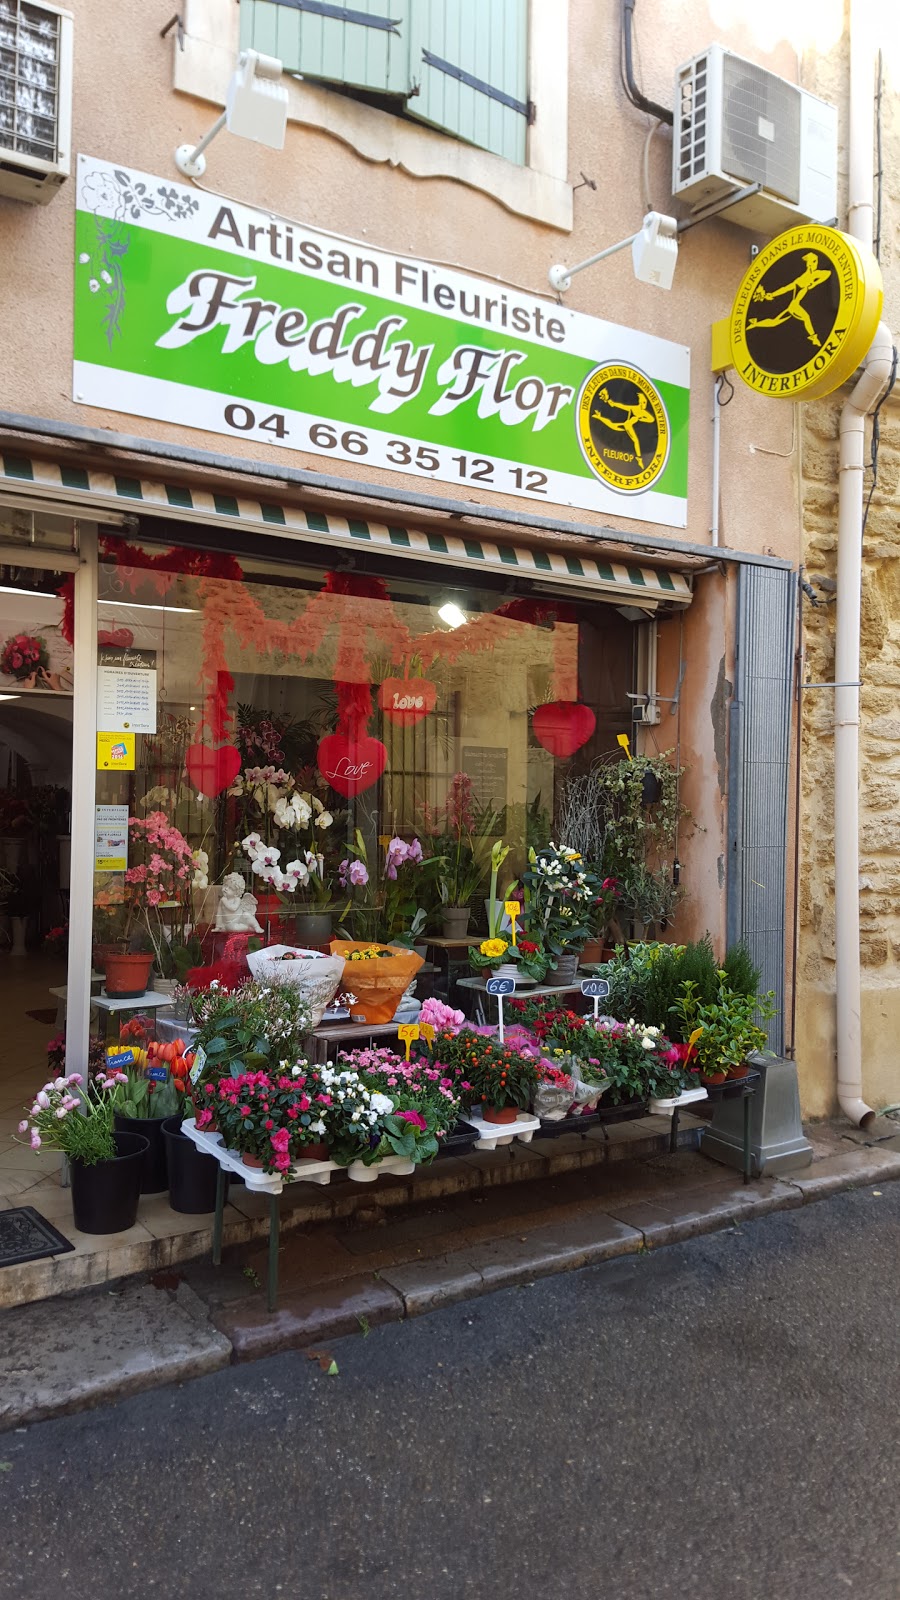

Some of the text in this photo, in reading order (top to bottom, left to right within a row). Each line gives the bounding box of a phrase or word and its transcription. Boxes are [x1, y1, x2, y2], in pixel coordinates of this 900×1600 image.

[208, 206, 566, 344] Artisan Fleuriste
[734, 232, 853, 344] DES FLEURS DANS LE MONDE ENTIER
[174, 271, 573, 418] Freddy Flor
[742, 327, 847, 392] INTERFLORA
[582, 368, 666, 435] DES FLEURS DANS LE MONDE ENTIER
[224, 403, 548, 494] 04 66 35 12 12
[584, 438, 663, 487] INTERFLORA
[603, 448, 634, 463] FLEUROP
[392, 692, 424, 710] love
[325, 757, 374, 781] Love
[489, 980, 510, 992] 6€
[583, 982, 605, 993] 10€
[401, 1025, 416, 1038] 5€
[107, 1054, 133, 1067] France
